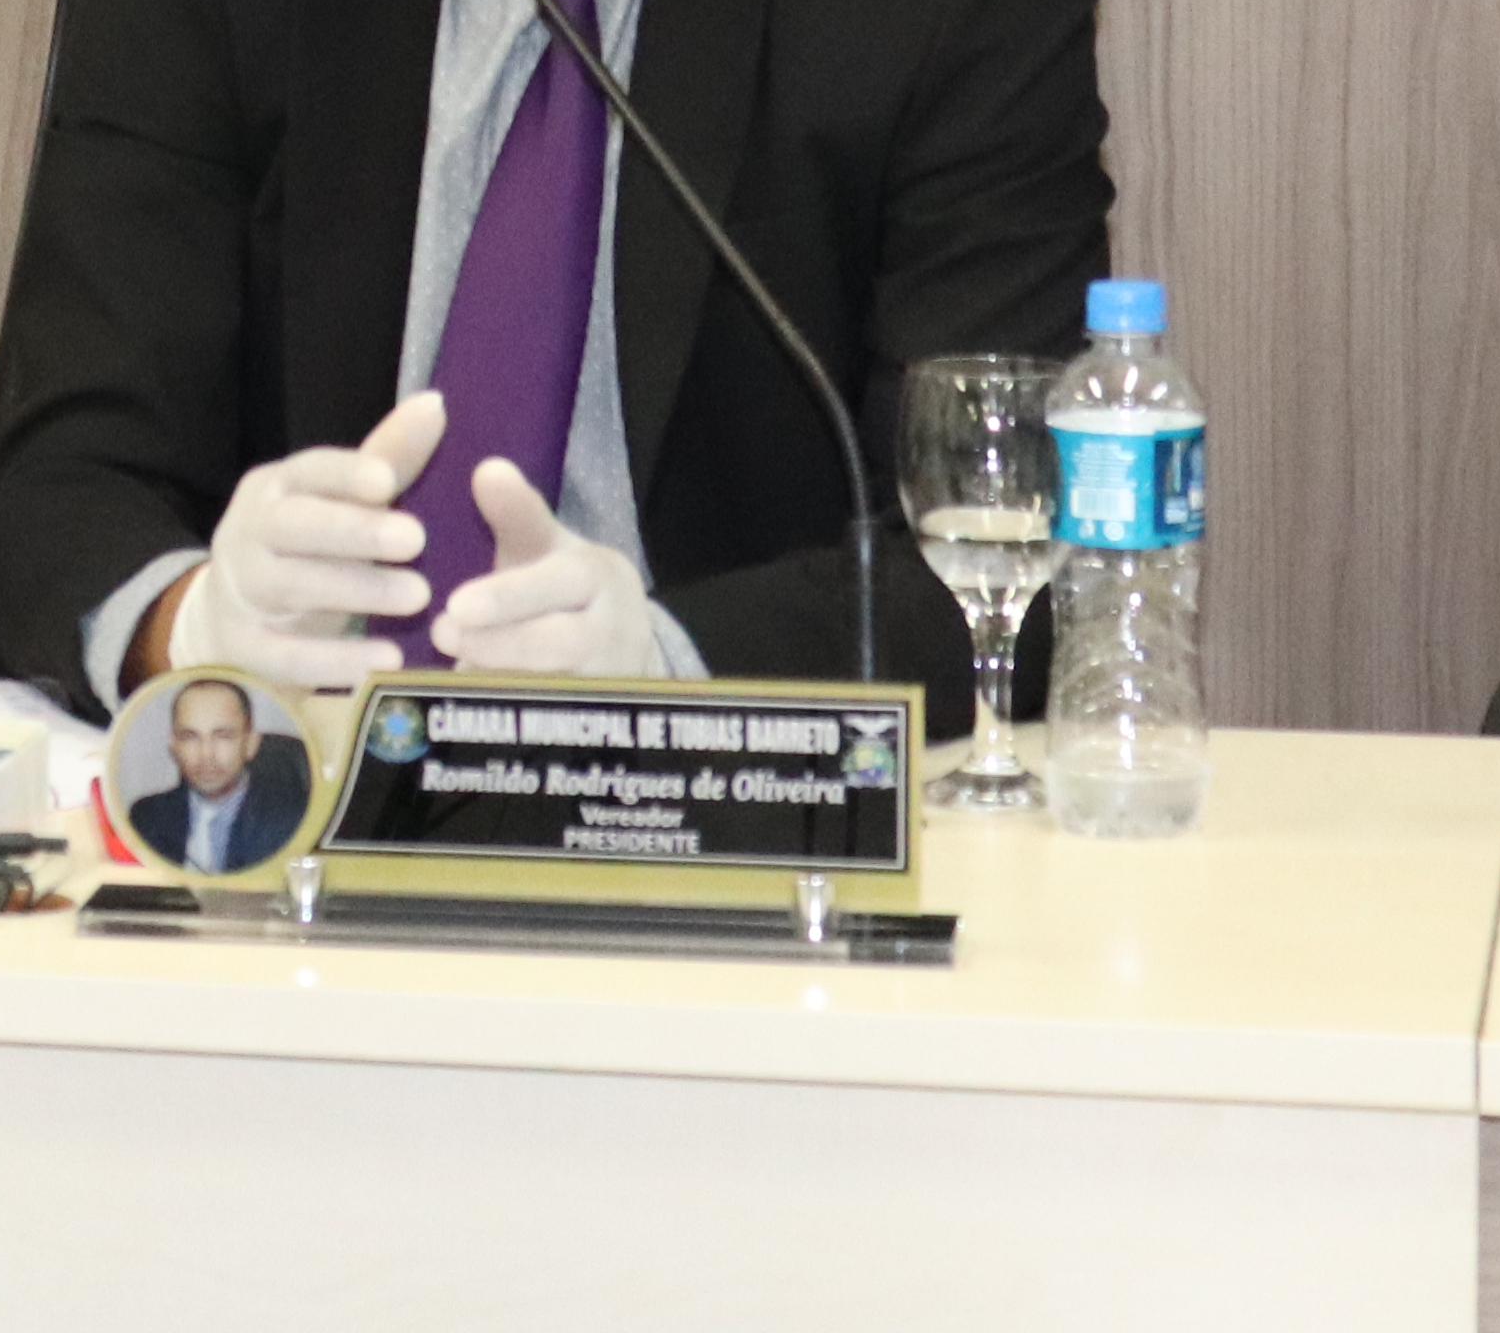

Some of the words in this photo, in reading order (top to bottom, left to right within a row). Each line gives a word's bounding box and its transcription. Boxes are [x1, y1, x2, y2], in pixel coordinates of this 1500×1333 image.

[519, 707, 634, 748] MUNICIPAL
[637, 712, 667, 749] DE
[670, 713, 743, 752] TOBIAS
[746, 715, 840, 755] BARRETO
[423, 761, 539, 795] Romildo
[546, 764, 685, 805] Rodrigues
[691, 769, 726, 800] de
[732, 771, 844, 804] Oliveira
[580, 805, 684, 828] Vereador
[563, 830, 700, 854] PRESIDENTE
